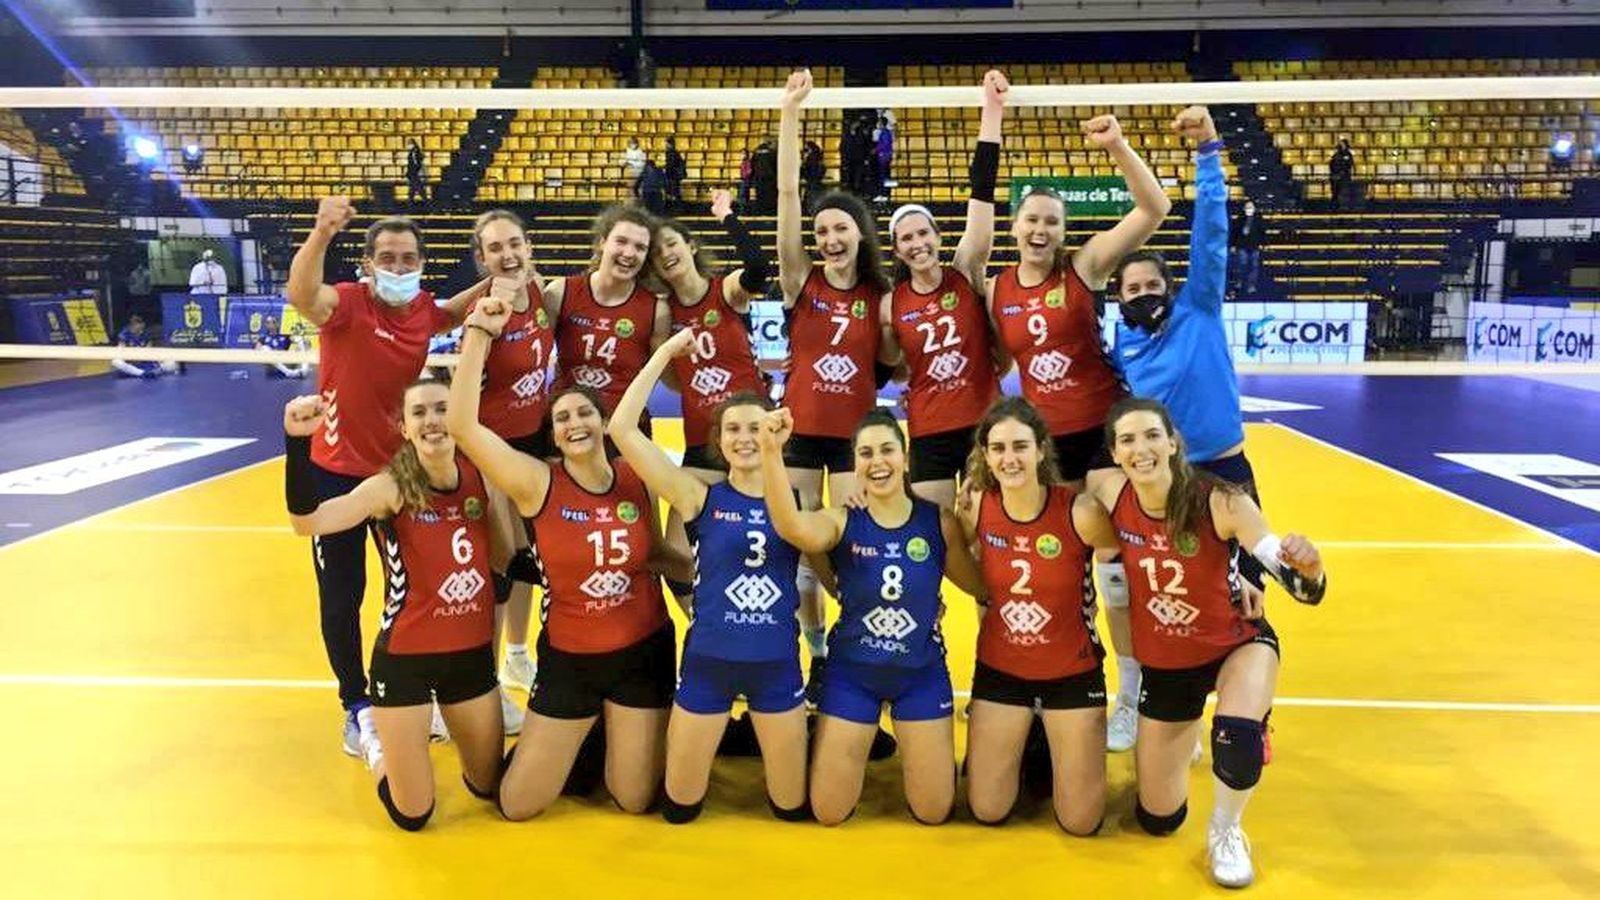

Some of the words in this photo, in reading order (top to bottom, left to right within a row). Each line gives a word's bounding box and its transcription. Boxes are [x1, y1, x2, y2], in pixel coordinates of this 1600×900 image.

[1088, 187, 1108, 202] de
[830, 315, 850, 346] 7
[916, 315, 961, 354] 22
[1027, 313, 1048, 346] 9
[530, 338, 543, 366] 1
[581, 333, 618, 366] 14
[451, 526, 474, 565] 6
[586, 529, 631, 567] 15
[744, 530, 767, 568] 3
[880, 564, 903, 601] 8
[1009, 558, 1033, 595] 2
[1138, 556, 1188, 595] 12
[724, 611, 778, 625] FUNDAL
